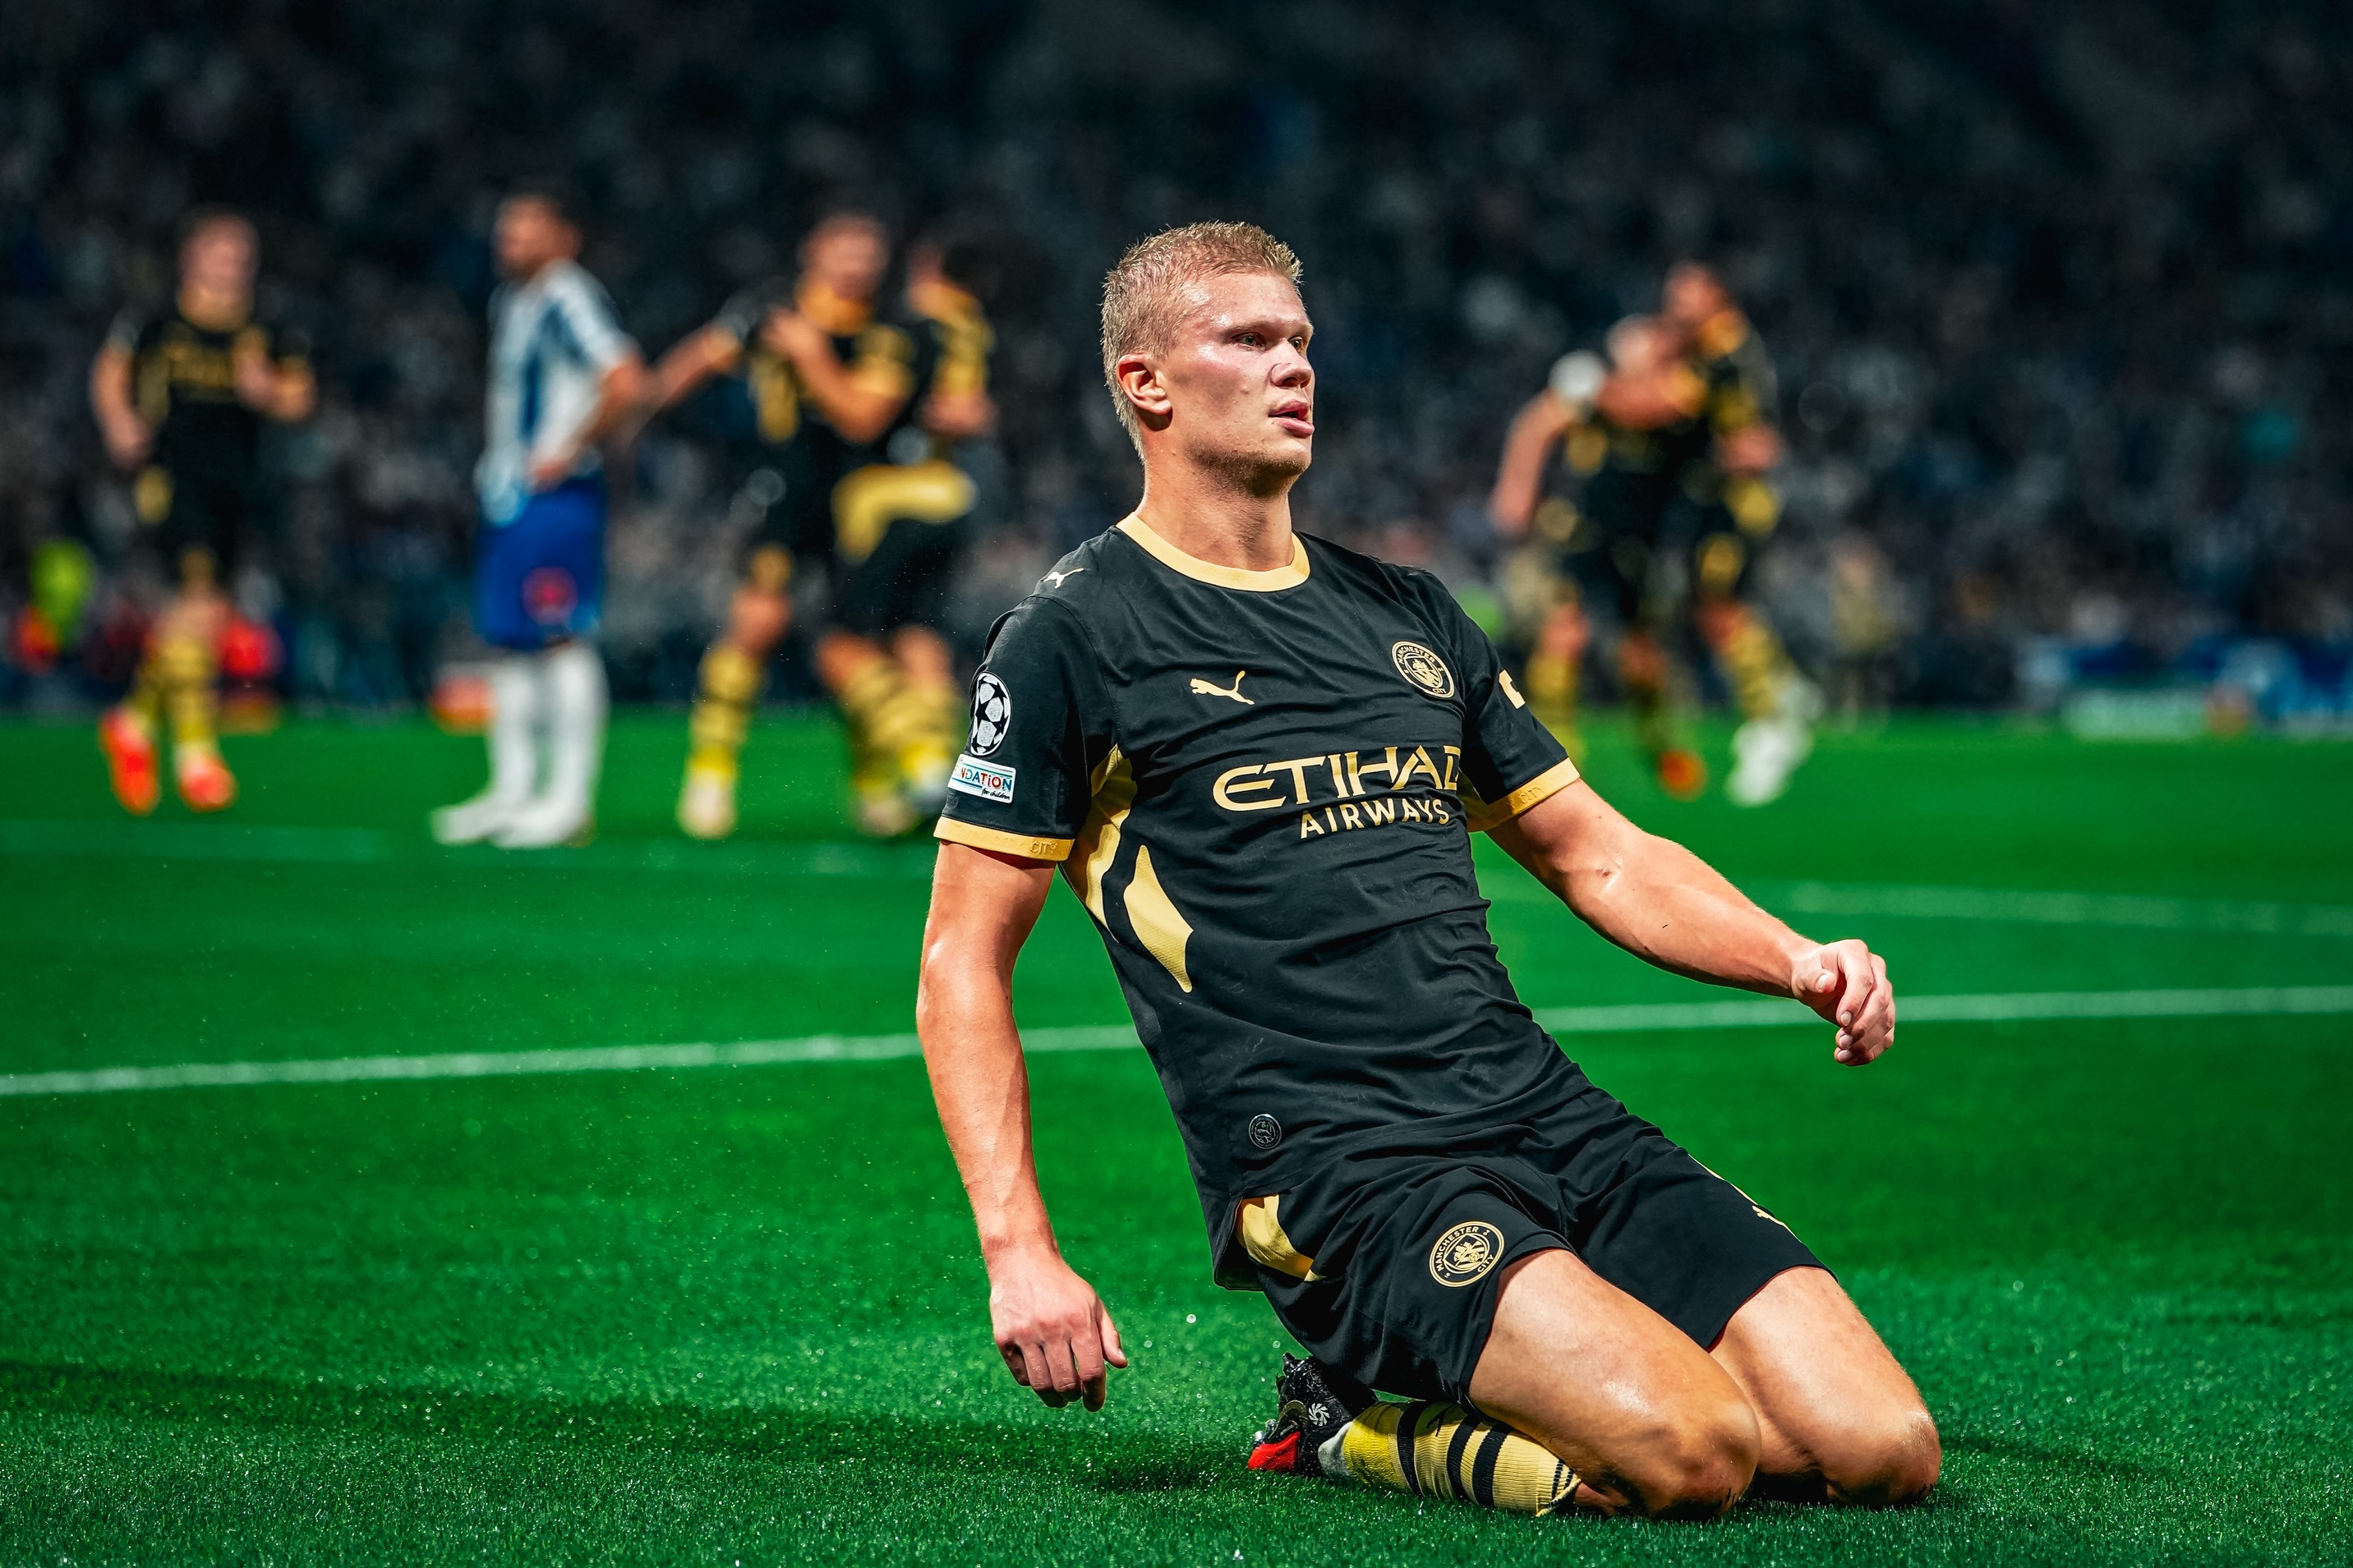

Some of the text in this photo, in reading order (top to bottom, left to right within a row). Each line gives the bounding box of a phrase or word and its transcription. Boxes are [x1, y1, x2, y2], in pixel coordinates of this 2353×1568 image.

[1398, 646, 1435, 664] MANCHESTER
[1213, 744, 1461, 812] ETIHAD
[1301, 798, 1450, 839] AIRWAYS
[1435, 1226, 1479, 1271] MANCHESTER
[1477, 1254, 1494, 1272] CITY
